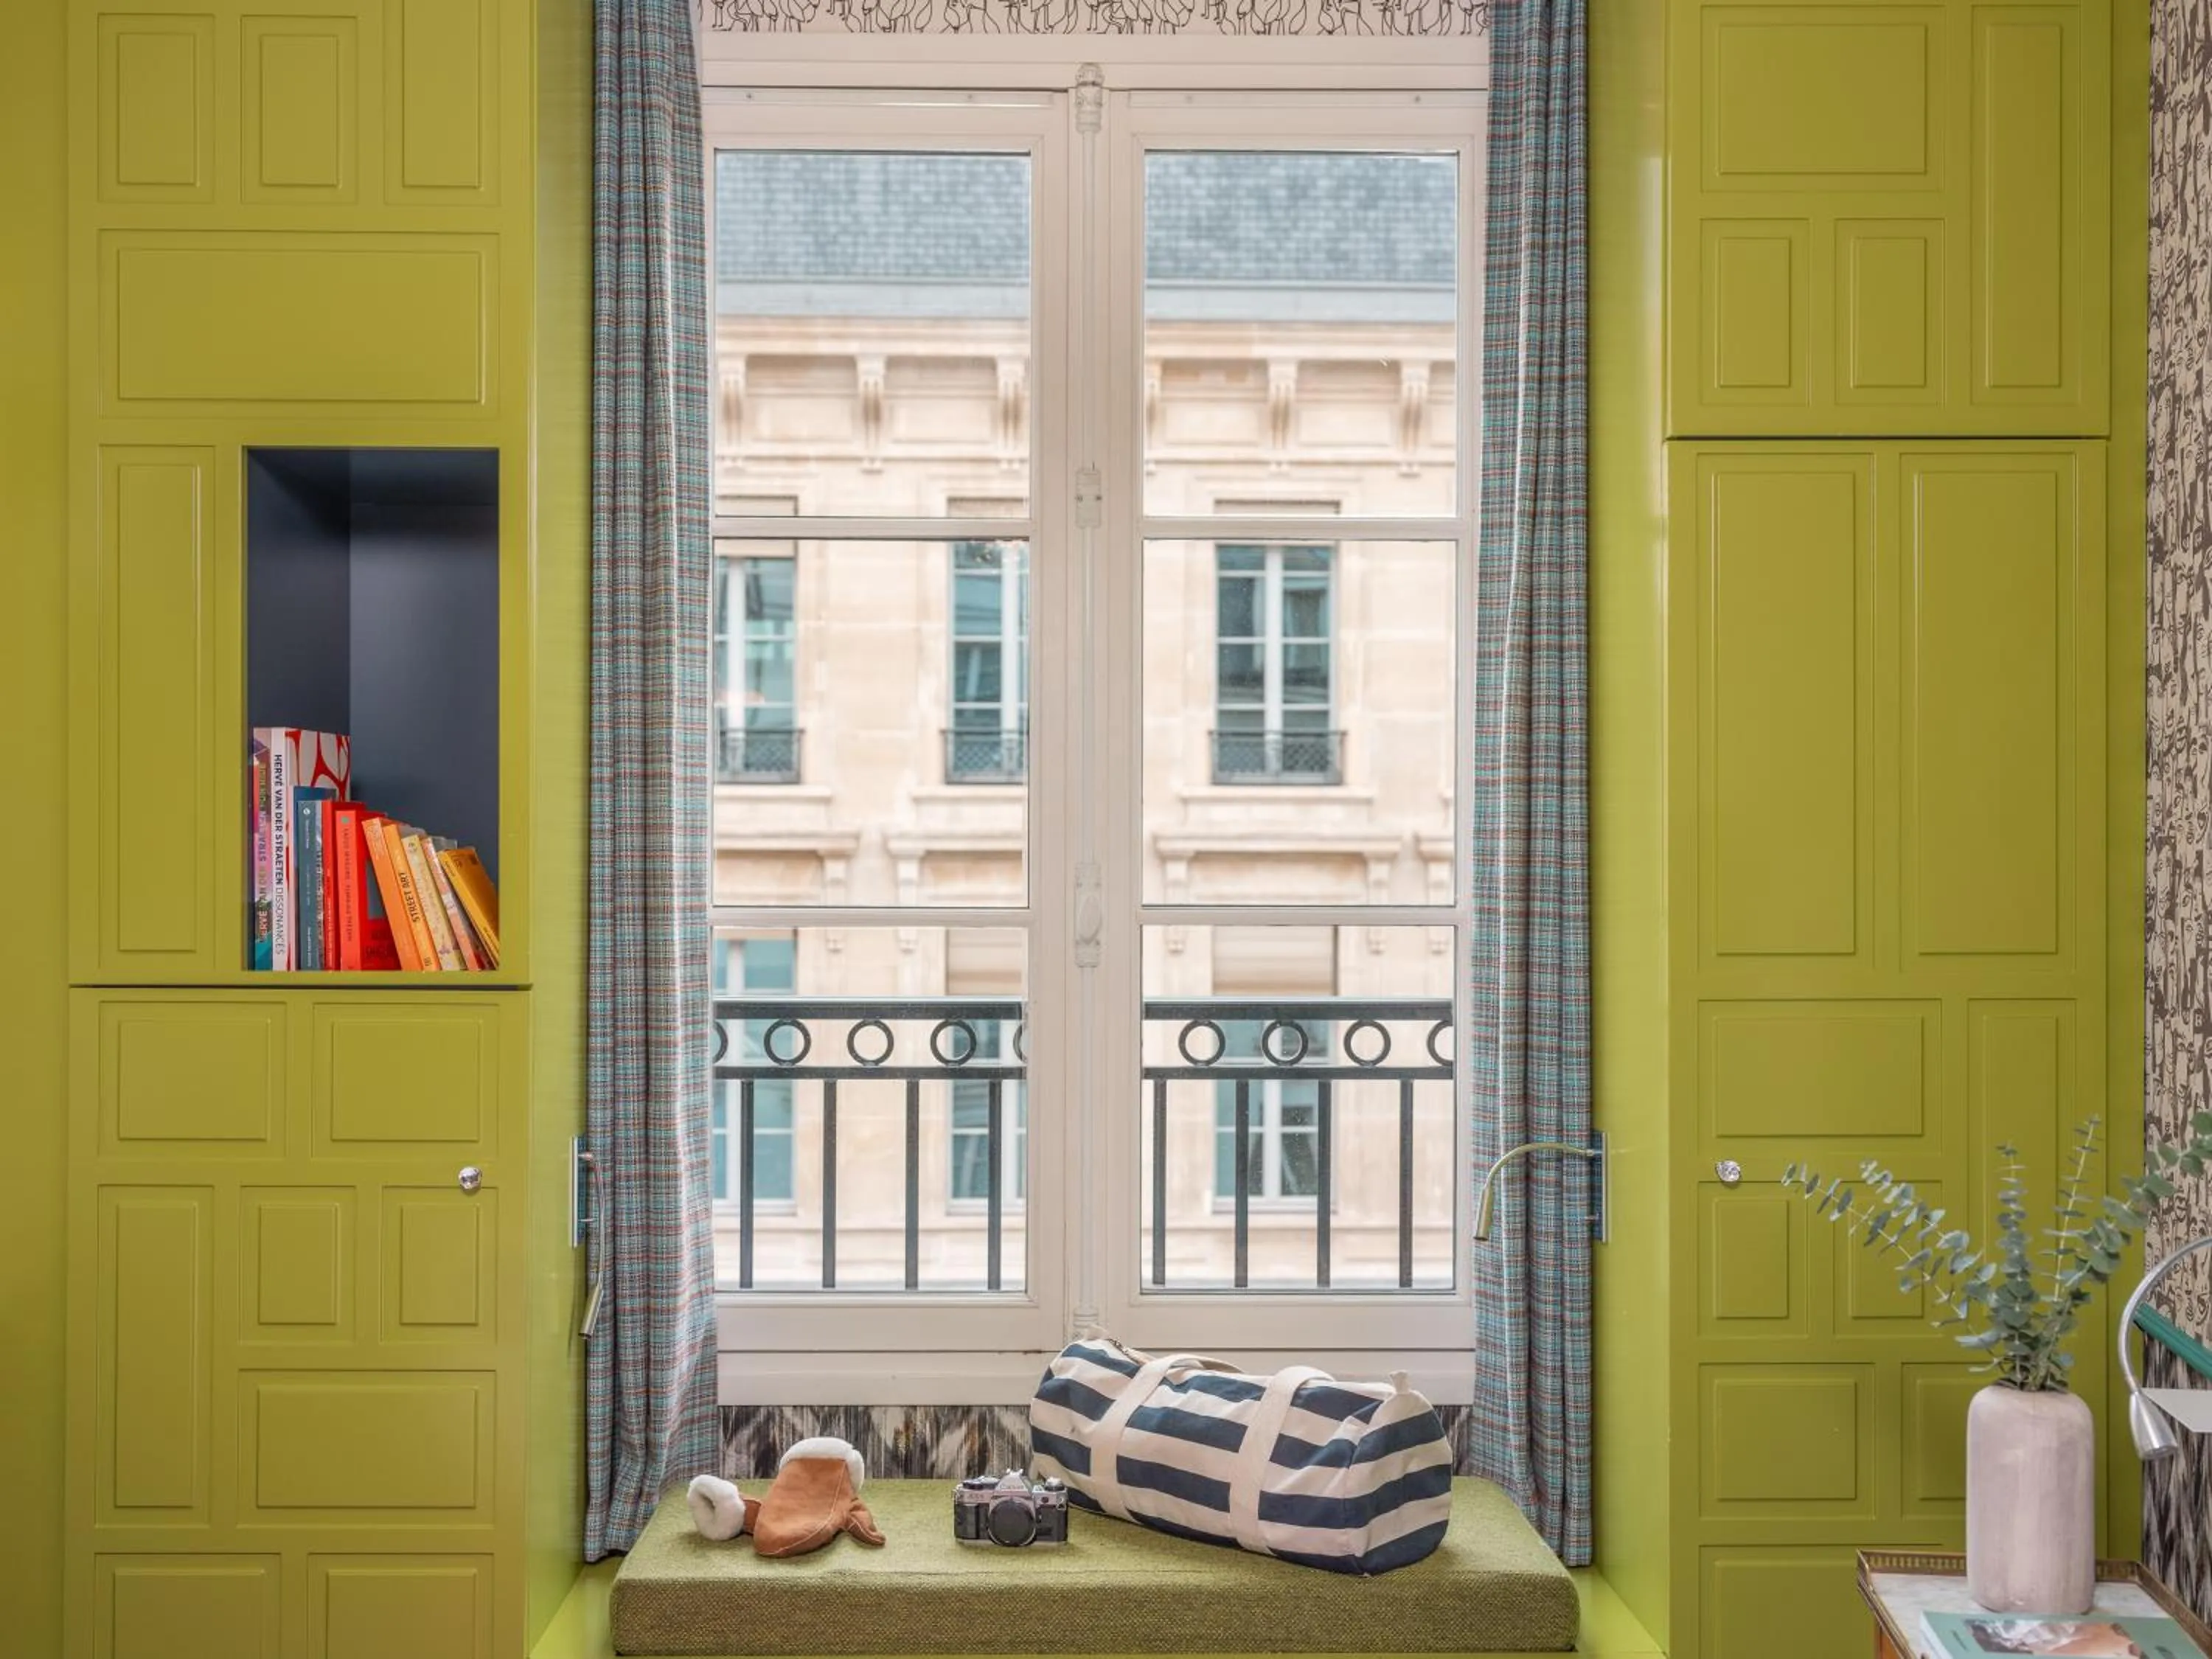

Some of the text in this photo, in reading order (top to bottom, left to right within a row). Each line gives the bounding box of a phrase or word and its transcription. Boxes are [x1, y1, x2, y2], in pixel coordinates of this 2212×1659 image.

[274, 754, 285, 955] HERVÉ VAN DER STRAETEN DISSONANCES
[399, 872, 420, 922] STREET ART
